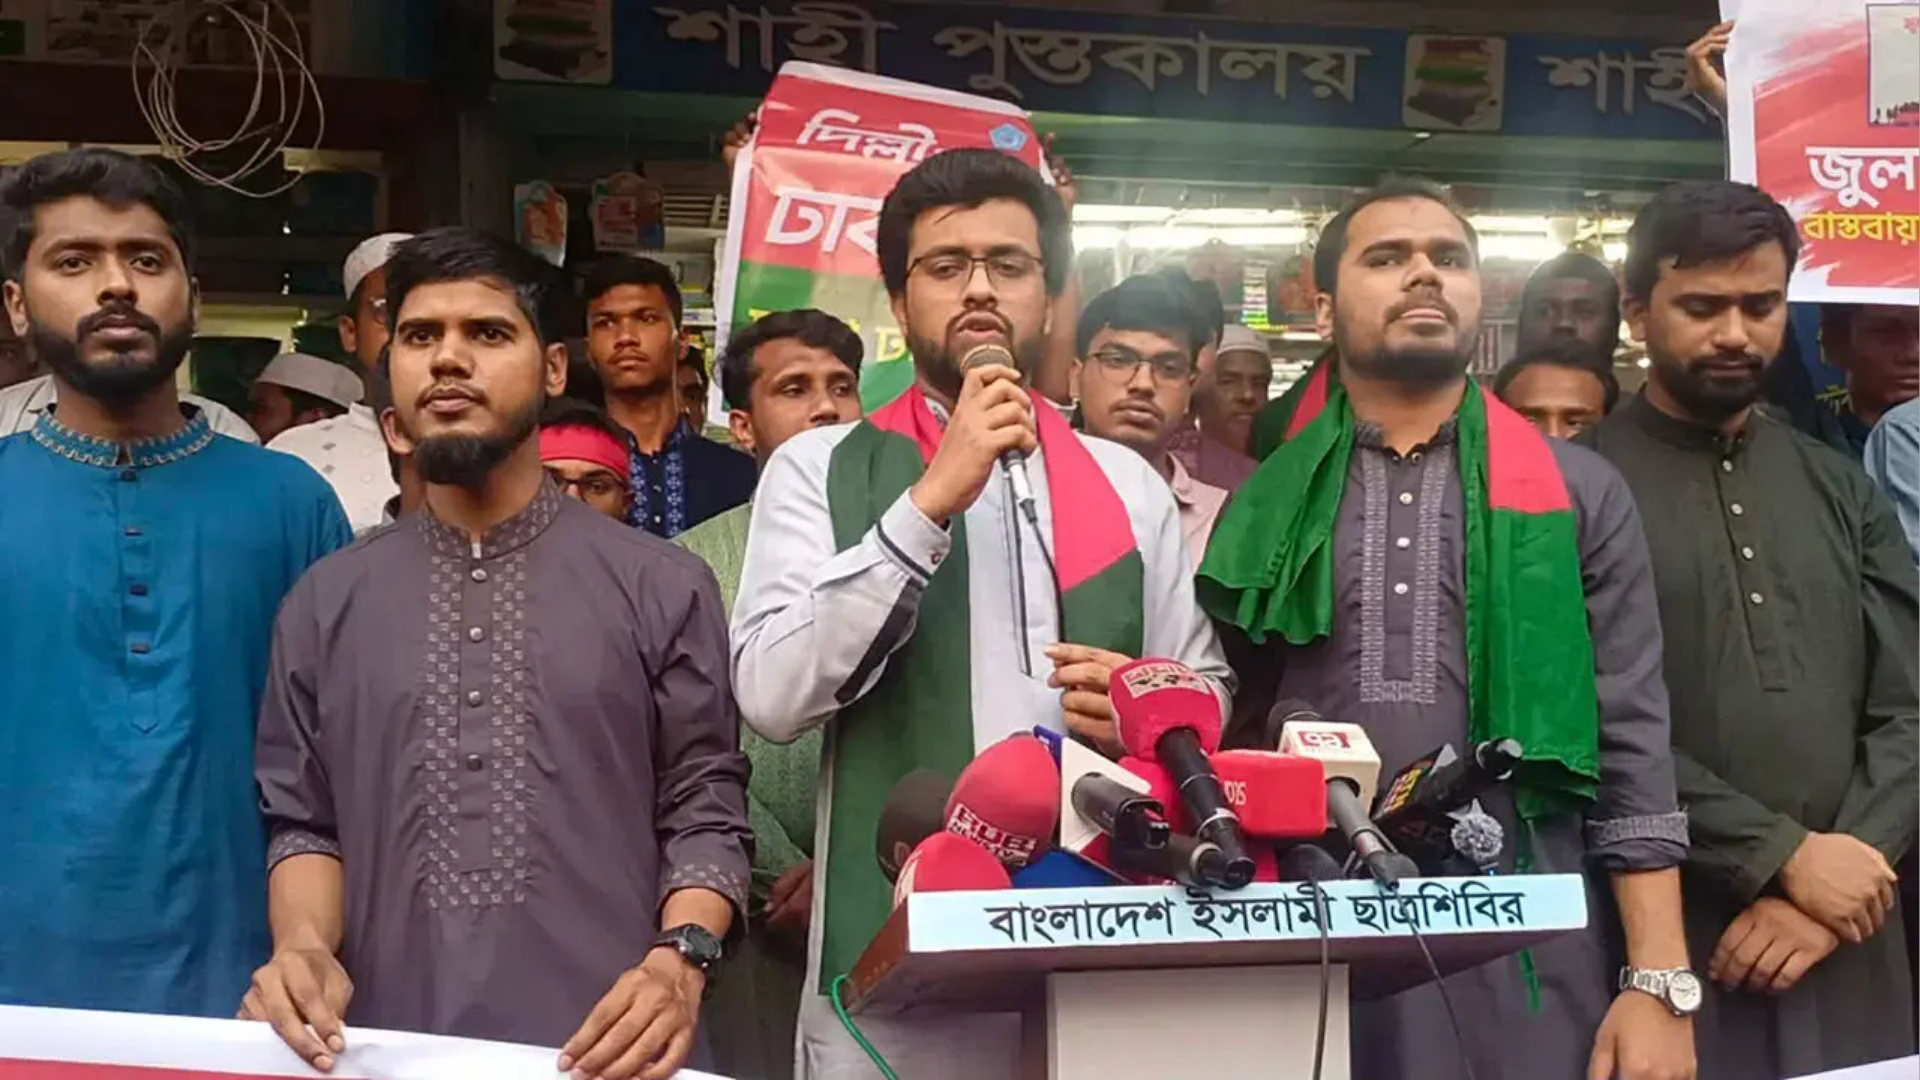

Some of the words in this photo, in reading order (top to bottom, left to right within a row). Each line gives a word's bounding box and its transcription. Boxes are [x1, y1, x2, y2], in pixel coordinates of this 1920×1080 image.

[653, 2, 898, 76] শাহী
[933, 20, 1371, 101] পুস্তকালয়
[984, 896, 1176, 943] বাংলাদেশ
[1186, 880, 1338, 937] ইসলামী
[1346, 880, 1526, 934] ছাত্রশিবির
